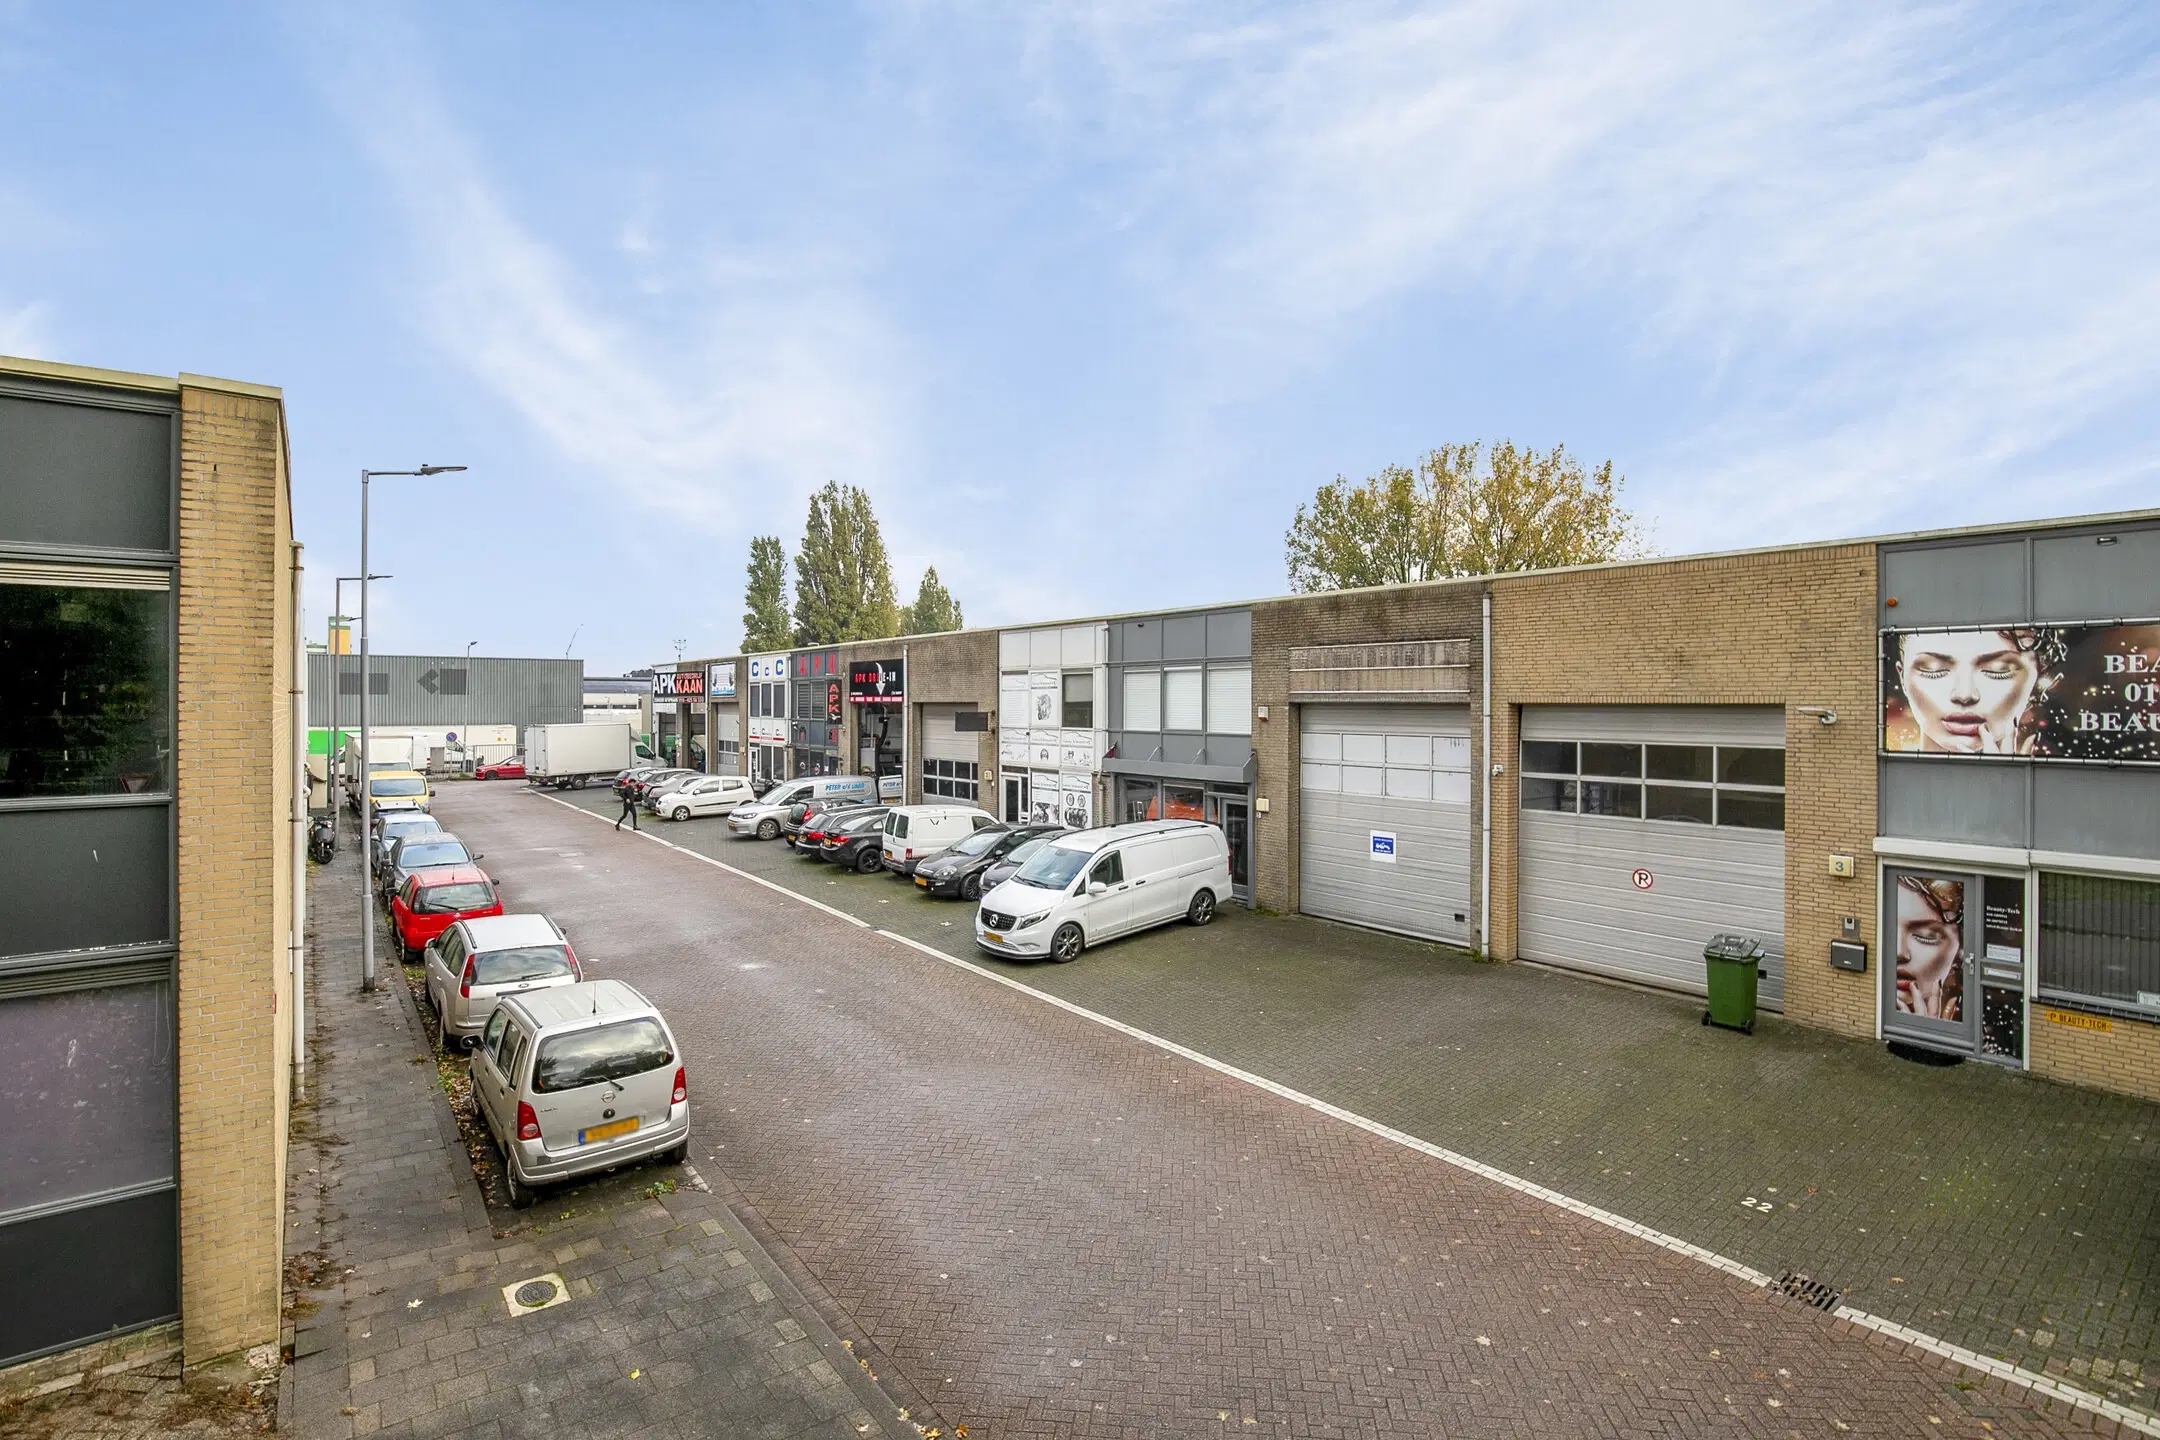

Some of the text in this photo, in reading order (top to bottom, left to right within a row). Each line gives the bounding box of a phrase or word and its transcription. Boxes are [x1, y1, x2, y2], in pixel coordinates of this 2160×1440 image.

[653, 674, 678, 694] APK
[677, 678, 703, 694] KAAN
[828, 683, 840, 713] APK
[1835, 861, 1845, 872] 3
[2059, 1014, 2107, 1030] BEAUTY-TECH
[1740, 1196, 1773, 1213] 22
